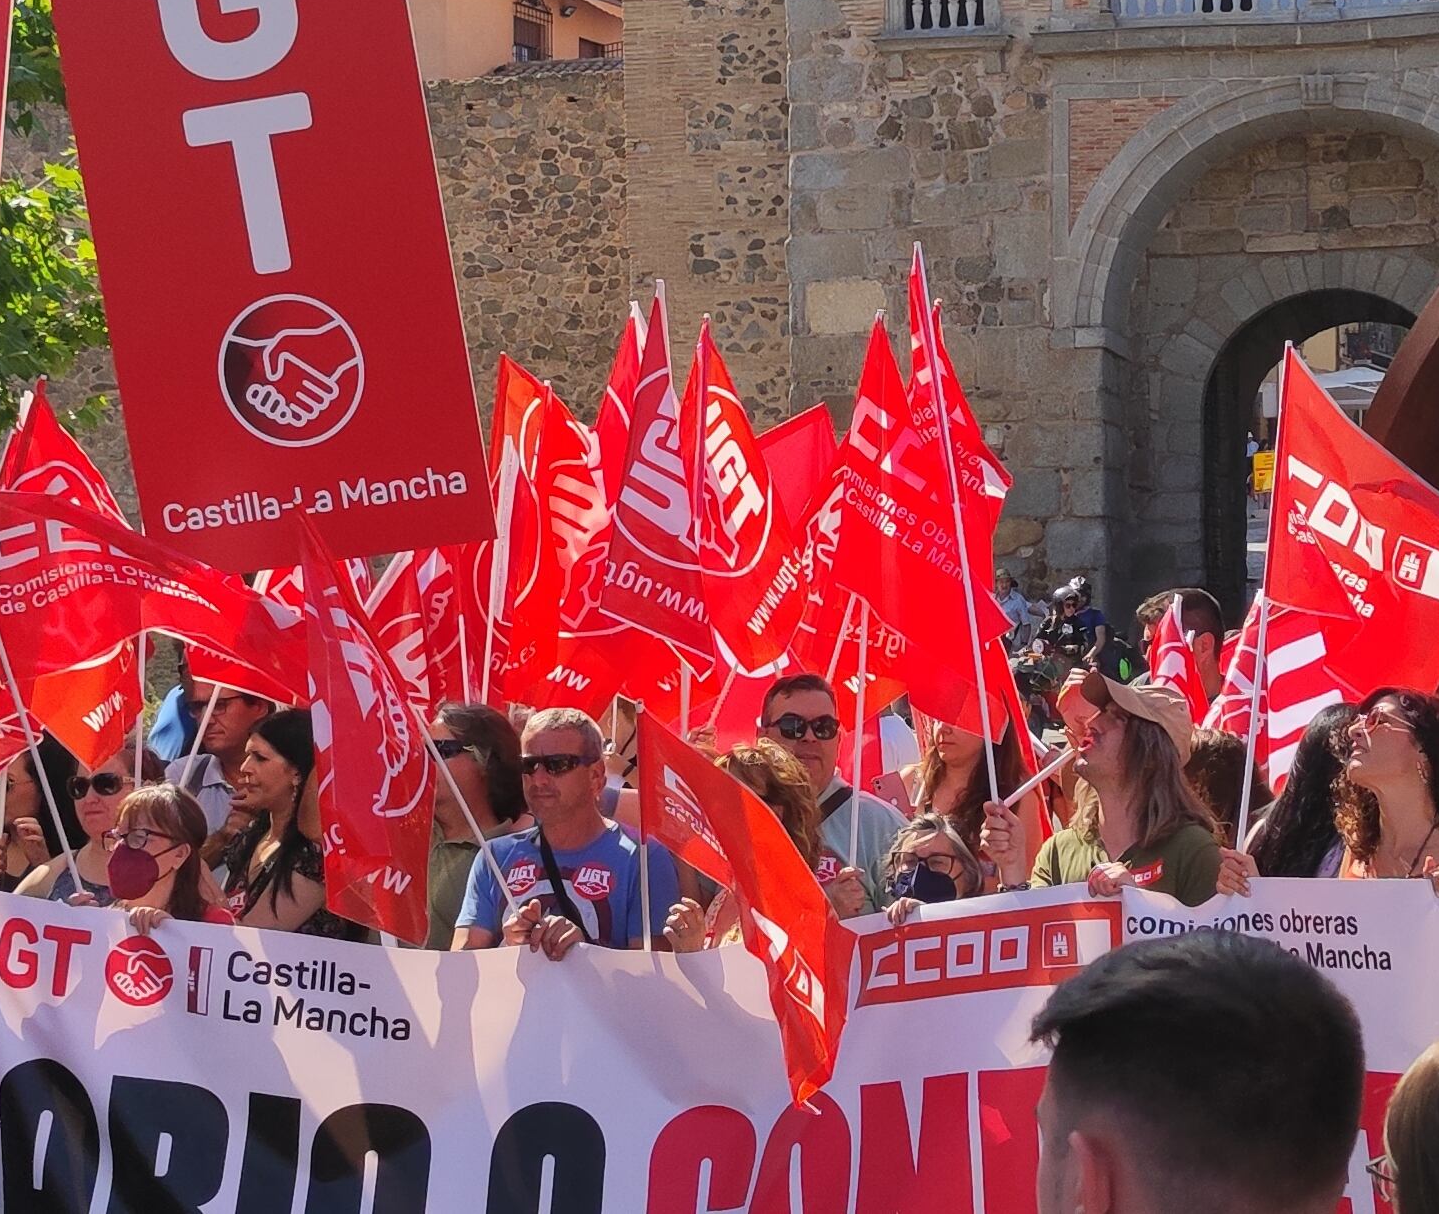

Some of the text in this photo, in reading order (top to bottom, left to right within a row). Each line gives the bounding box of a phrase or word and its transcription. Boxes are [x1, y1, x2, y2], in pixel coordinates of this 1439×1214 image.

[338, 466, 468, 510] Mancha
[0, 599, 27, 616] de
[31, 571, 138, 608] Castilla-La
[507, 864, 536, 883] UGT
[577, 867, 611, 886] UGT
[1280, 907, 1359, 937] obreras
[225, 949, 372, 997] Castilla-
[867, 924, 1029, 992] CCOO
[1305, 941, 1392, 971] Mancha
[222, 991, 412, 1042] La Mancha
[486, 1101, 606, 1214] O
